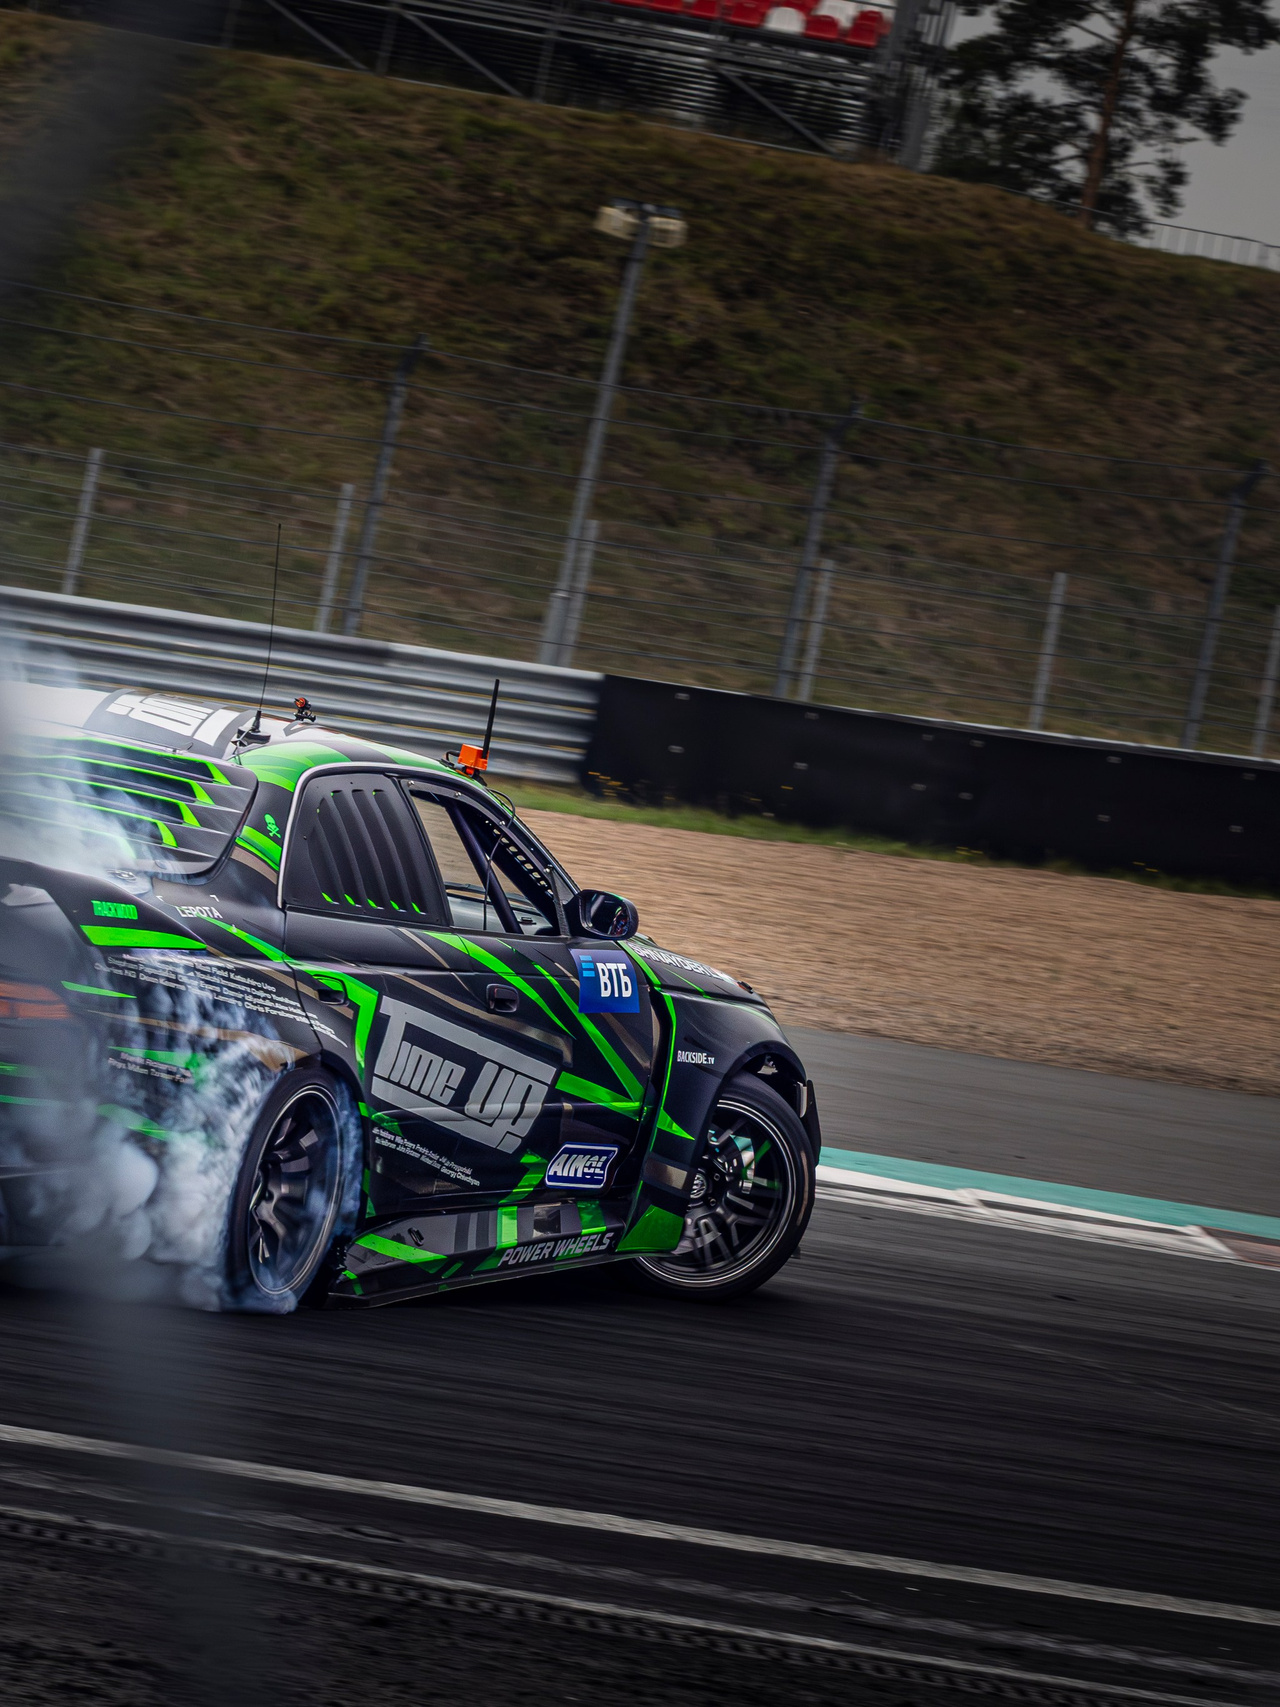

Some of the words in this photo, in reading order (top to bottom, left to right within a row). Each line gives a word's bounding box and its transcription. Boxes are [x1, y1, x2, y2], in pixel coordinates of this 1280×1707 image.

[596, 963, 632, 997] ВТБ
[676, 1050, 715, 1065] BACKSIDE.TV
[497, 1241, 555, 1268] POWER
[551, 1232, 615, 1259] WHEELS
